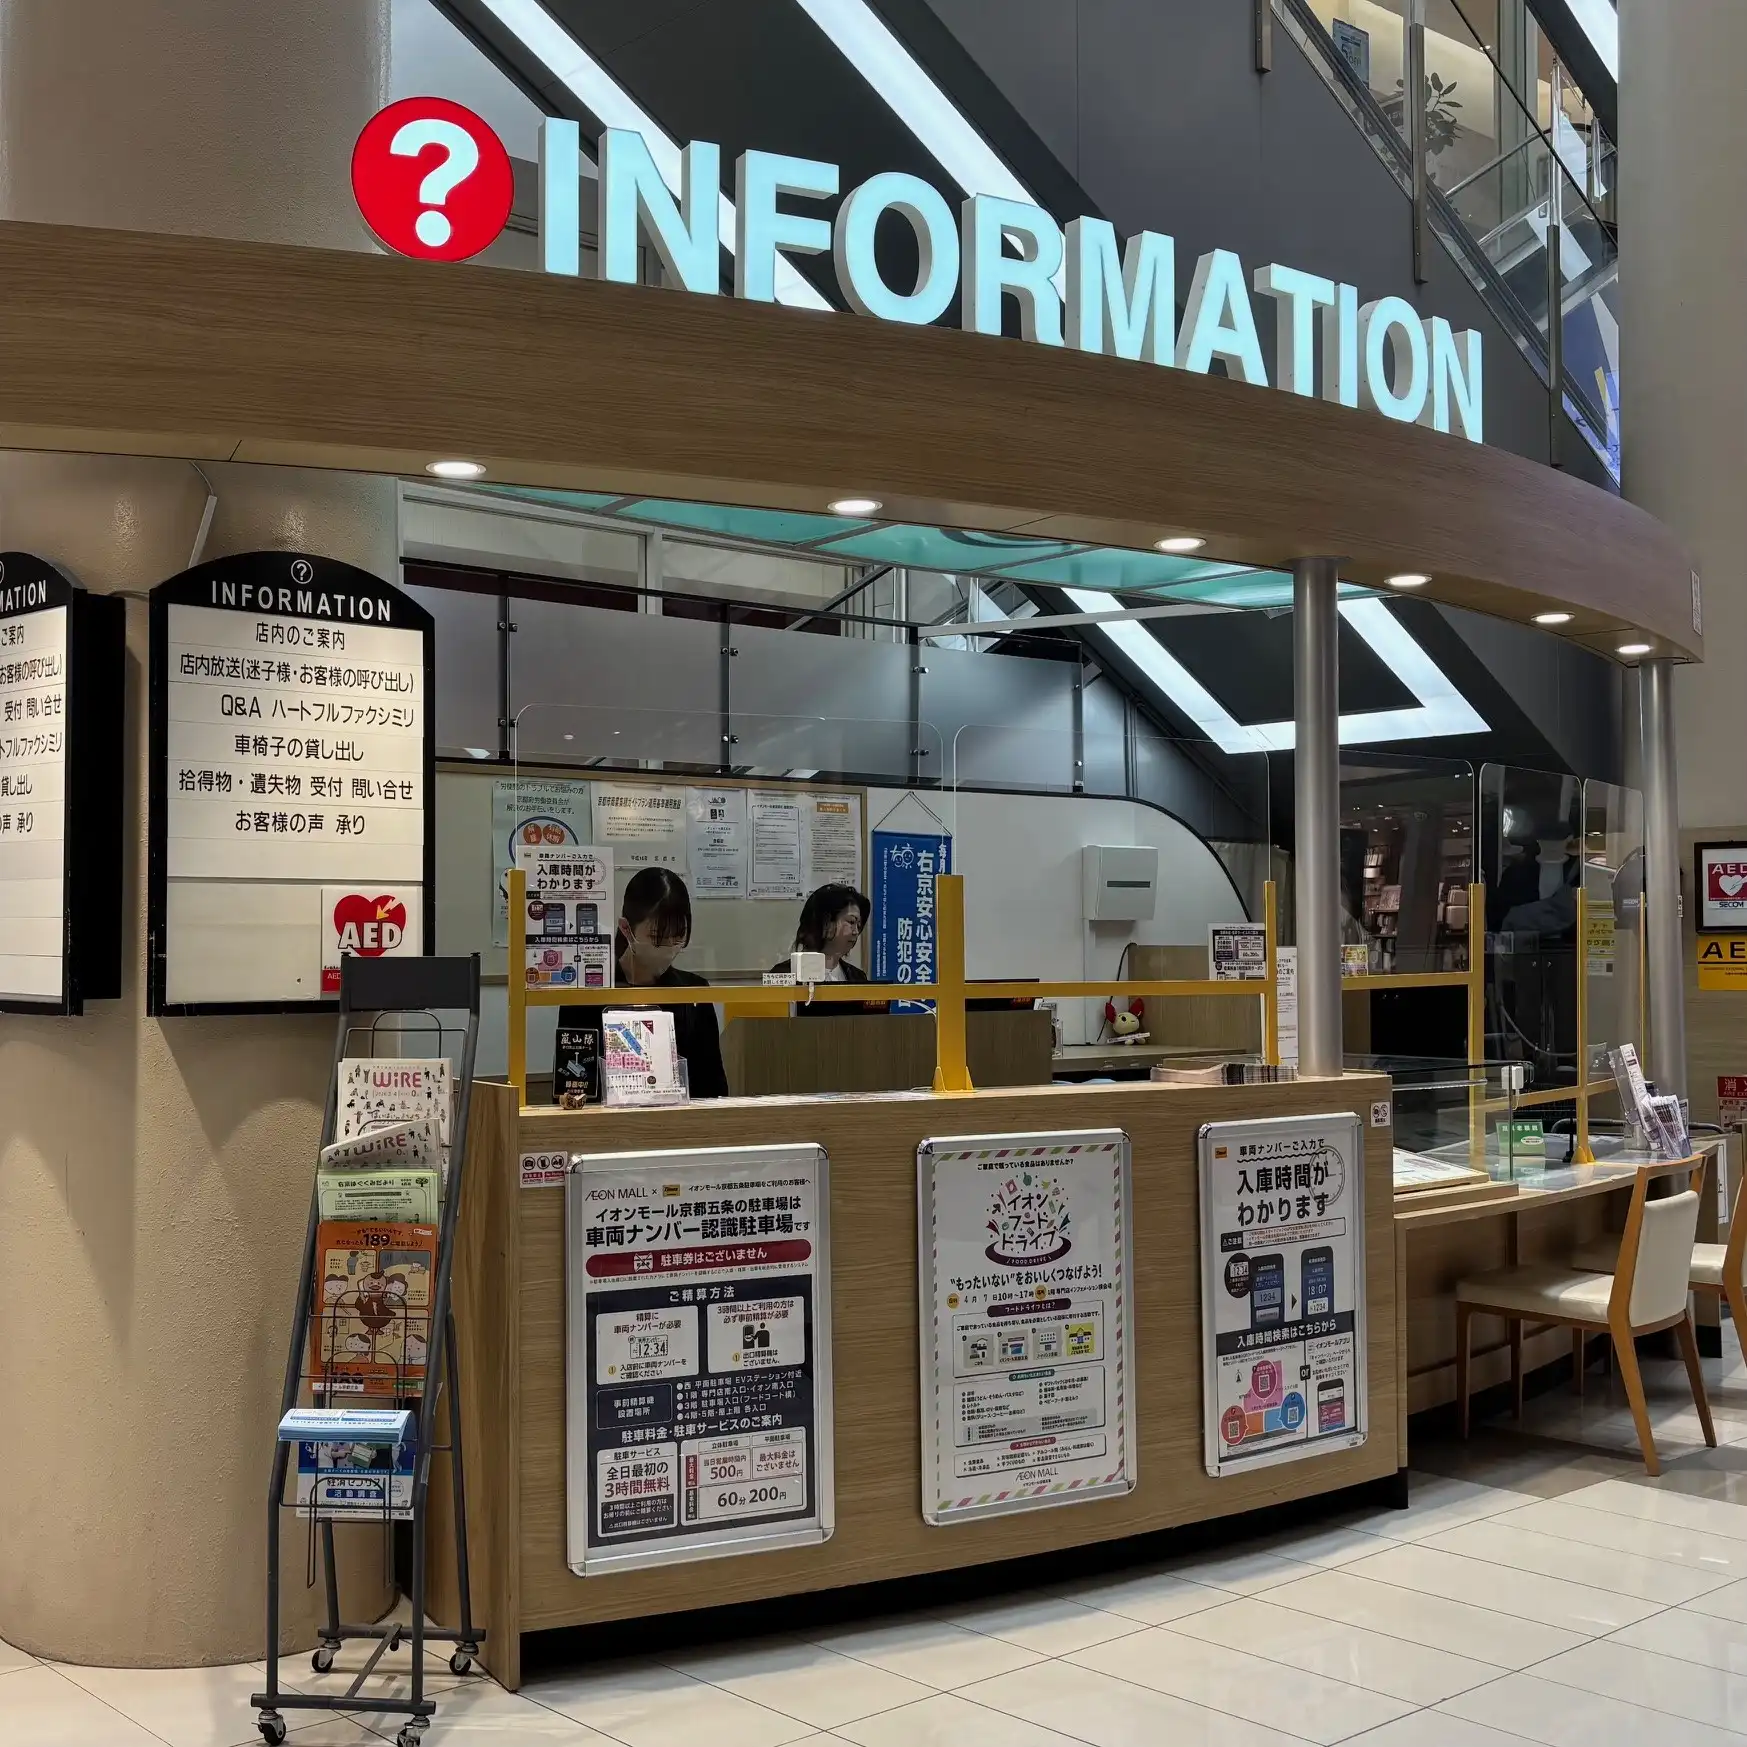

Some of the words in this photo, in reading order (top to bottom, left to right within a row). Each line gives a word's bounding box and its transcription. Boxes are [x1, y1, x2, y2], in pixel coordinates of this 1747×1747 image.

[541, 116, 1483, 444] INFORMATION
[211, 580, 391, 622] INFORMATION
[2, 624, 25, 646] ご案内
[255, 621, 346, 651] 店内のご案内
[180, 652, 414, 694] 店内放送(迷子様・お客様の呼び出し)
[4, 699, 22, 722] 受付
[26, 693, 62, 719] 問い合せ
[221, 694, 262, 719] Q&A
[271, 699, 415, 728] ハートフルファクシミリ
[234, 734, 365, 762] 車椅子の貸し出し
[1, 773, 33, 797] 貸し出し
[178, 768, 301, 796] 拾得物・遺失物
[310, 775, 343, 798] 受付
[351, 778, 414, 801] 問い合せ
[17, 811, 34, 834] 承り
[234, 810, 325, 834] お客様の声
[335, 814, 366, 835] 承り
[536, 863, 596, 877] 入庫時間が
[536, 878, 596, 890] わかります
[337, 921, 403, 950] AED
[372, 1071, 422, 1088] WiRE
[1239, 1138, 1325, 1157] 車両ナンバーご入力で
[1236, 1160, 1330, 1196] 入庫時間が
[617, 1186, 649, 1199] MALL
[1007, 1192, 1049, 1211] イオン
[595, 1196, 801, 1223] イオンモール京都五条の駐車場は
[1237, 1192, 1330, 1226] わかります
[585, 1213, 811, 1248] 車両ナンバー認識駐車場です
[1009, 1211, 1049, 1231] フード
[363, 1233, 391, 1247] 189
[1001, 1226, 1059, 1252] ドライブ
[660, 1246, 768, 1267] 駐車券はございません
[669, 1285, 736, 1301] ご精算方法
[1260, 1293, 1276, 1302] 1234
[1308, 1284, 1327, 1296] 18:07
[636, 1311, 659, 1322] 精算に
[717, 1299, 795, 1314] 3時間以上ご利用の方は
[613, 1319, 682, 1334] 車両ナンバーが必要
[723, 1311, 789, 1324] 必ず事前精算が必要
[1236, 1318, 1338, 1349] 入庫時間検索はこちらから
[620, 1369, 663, 1380] ご確認ください
[1301, 1367, 1310, 1377] or
[617, 1407, 651, 1419] 設置場所
[621, 1413, 783, 1444] 駐車料金・駐車サービスのご案内
[613, 1447, 661, 1461] 駐車サービス
[759, 1450, 796, 1462] 最大料金は
[606, 1461, 669, 1482] 全日最初の
[710, 1464, 744, 1480] 500円
[756, 1460, 800, 1473] ございません
[1037, 1467, 1059, 1478] MALL
[604, 1475, 671, 1498] 3時間無料
[717, 1491, 747, 1508] 60分
[749, 1486, 787, 1504] 200円
